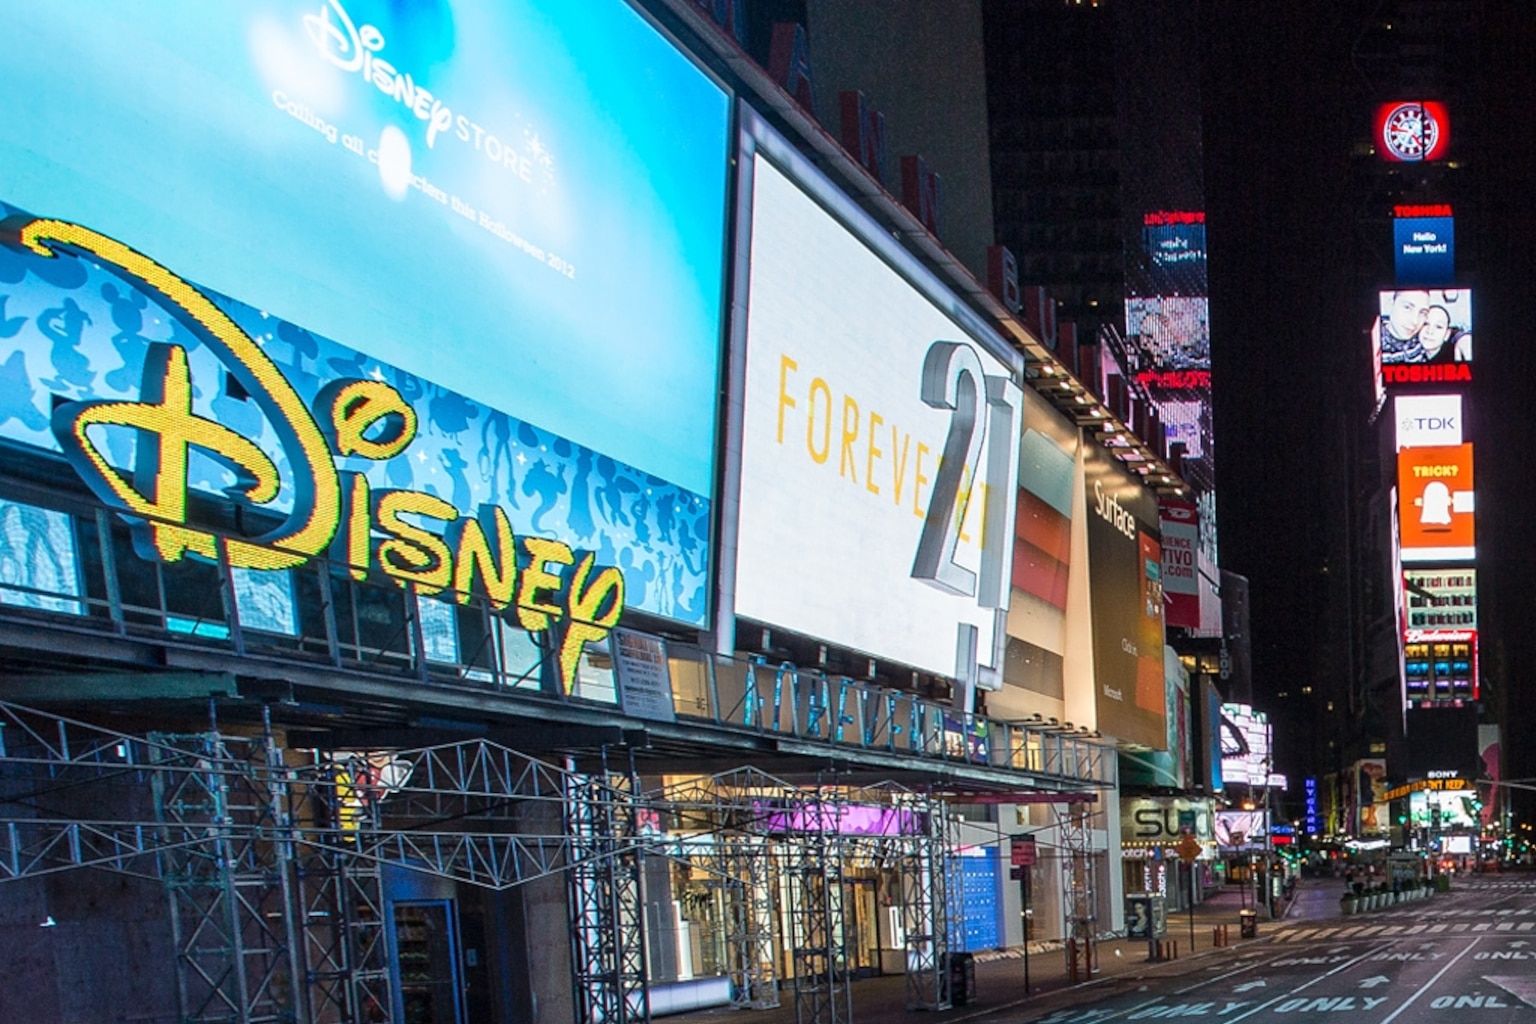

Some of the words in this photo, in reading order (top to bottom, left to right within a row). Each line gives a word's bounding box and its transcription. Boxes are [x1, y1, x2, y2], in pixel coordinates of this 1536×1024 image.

[456, 115, 532, 183] STORE
[272, 90, 337, 144] Calling
[342, 133, 364, 156] all
[451, 195, 476, 222] this
[480, 211, 545, 262] Halloween
[547, 252, 576, 280] 2012
[1394, 205, 1452, 217] TOSHIBA
[1413, 233, 1436, 241] Hello
[1403, 244, 1423, 253] New
[1382, 364, 1472, 382] TOSHIBA
[1414, 417, 1455, 430] TDK
[777, 353, 945, 520] FOREVE
[1412, 465, 1458, 478] TRICK?
[1094, 479, 1136, 541] Surface
[1404, 629, 1472, 643] Budweiser
[1220, 638, 1230, 680] 1500
[1427, 770, 1458, 779] SONY
[1128, 1001, 1257, 1020] ONLY
[1274, 996, 1387, 1012] ONLY
